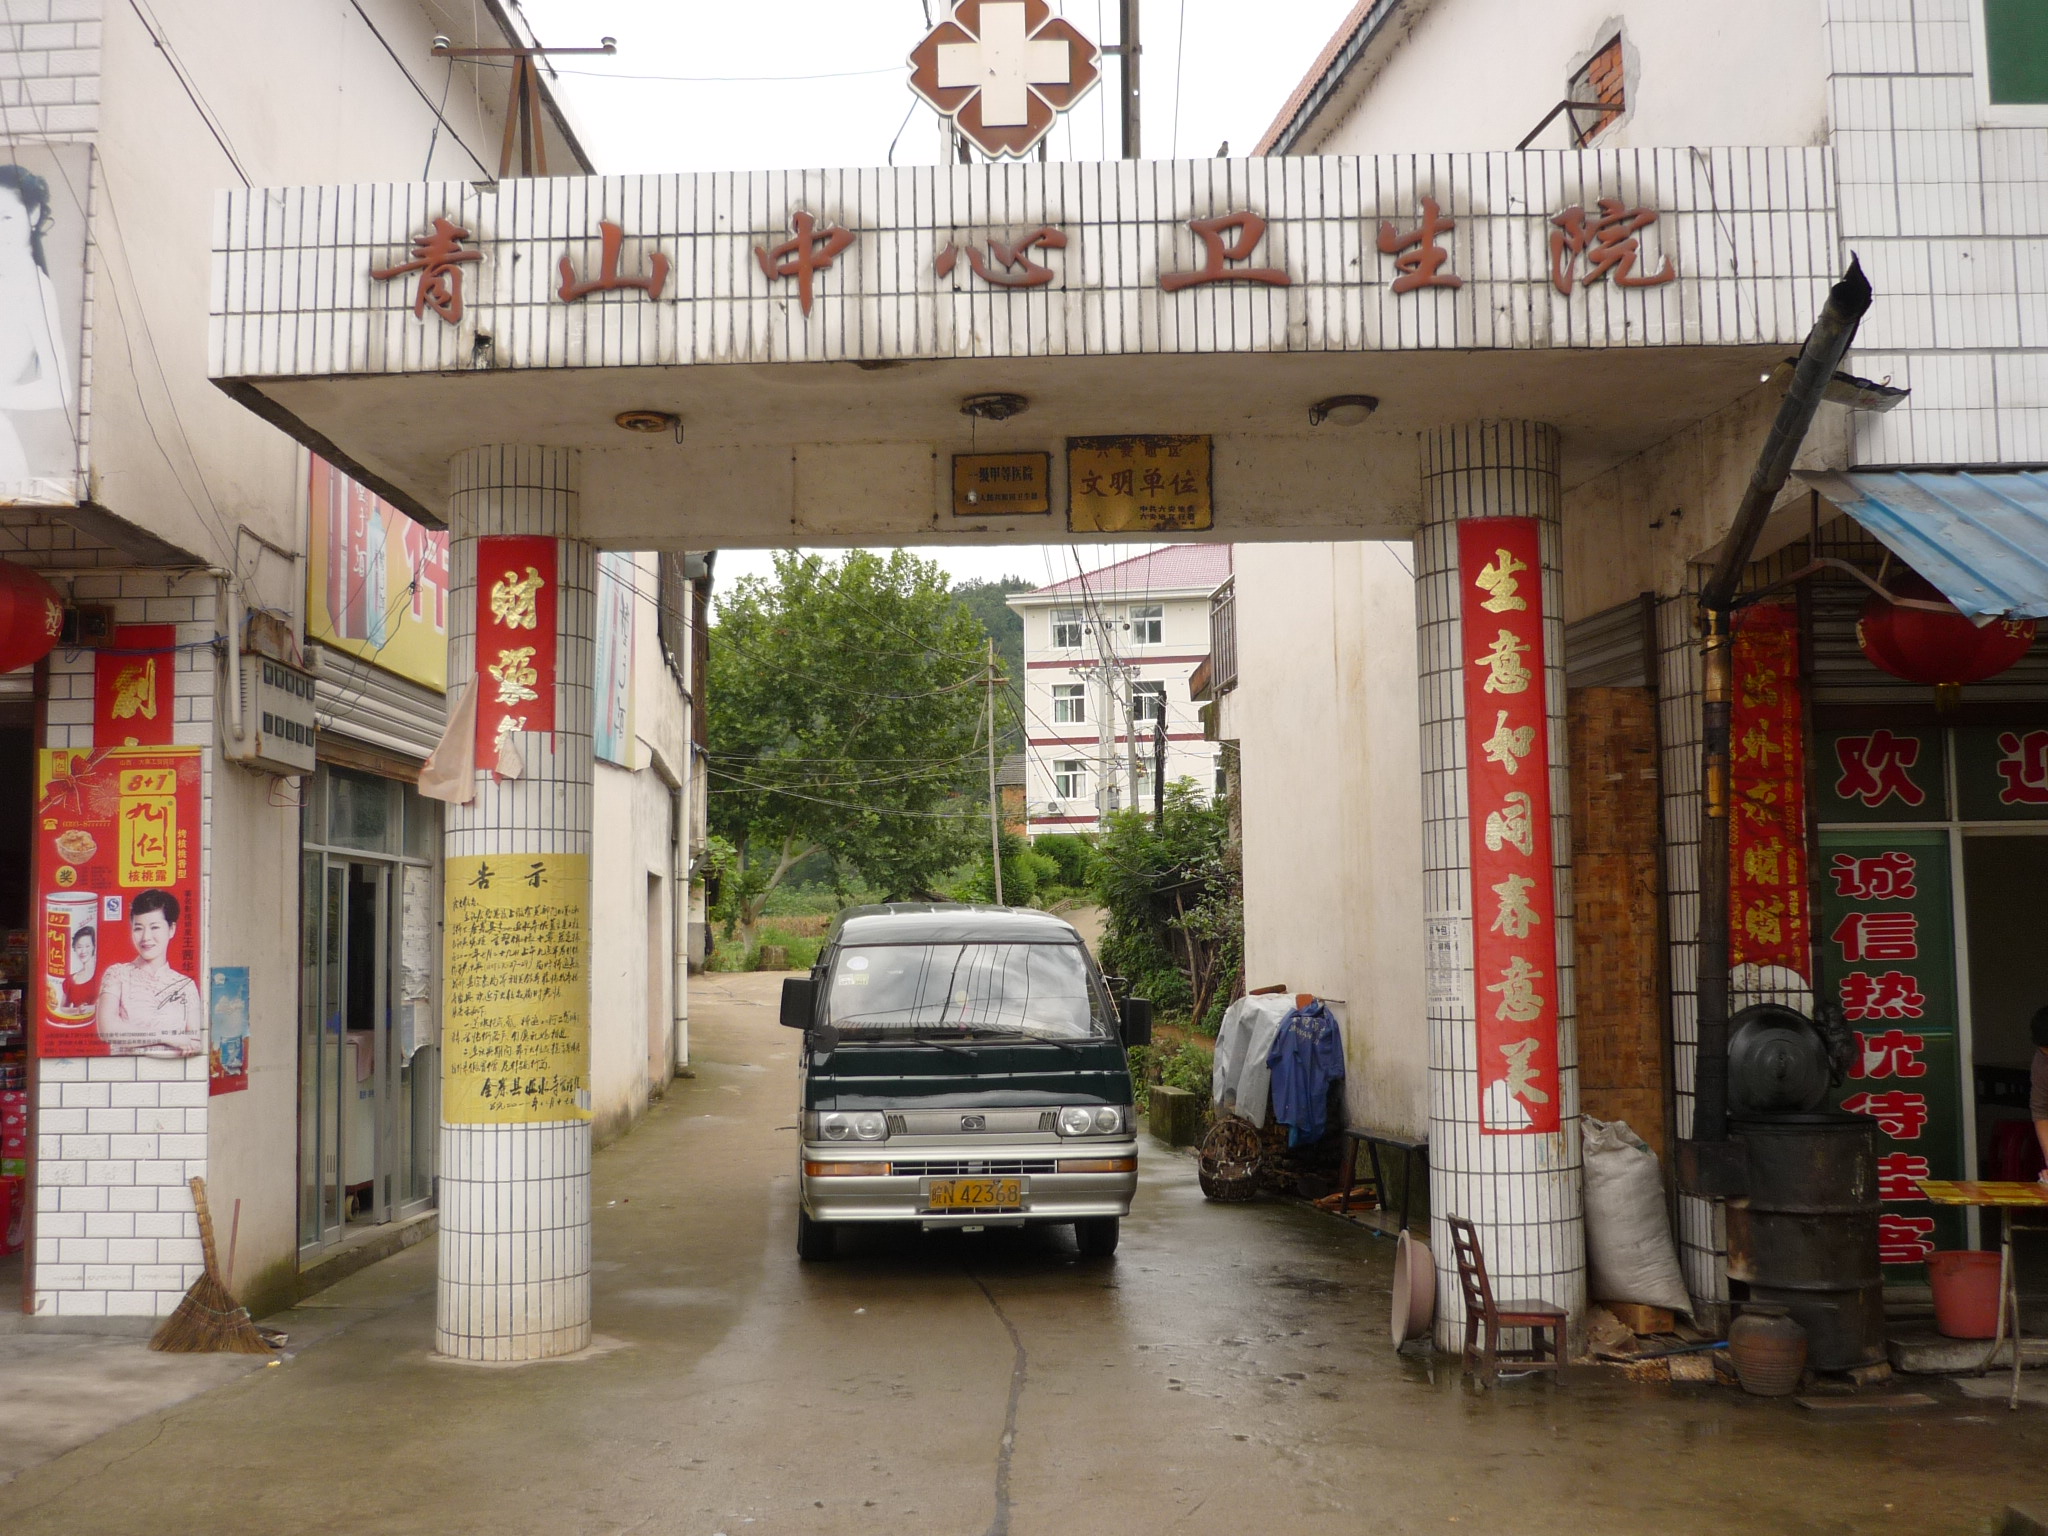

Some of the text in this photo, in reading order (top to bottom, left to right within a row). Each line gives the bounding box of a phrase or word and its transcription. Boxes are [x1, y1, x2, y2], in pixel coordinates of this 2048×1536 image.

[369, 198, 1677, 326] 青山中心卫生院
[1080, 468, 1199, 497] 文明单位
[128, 774, 168, 791] 8+1
[128, 870, 167, 882] 核桃露
[469, 861, 548, 889] 告示
[960, 1184, 1018, 1203] 42368
